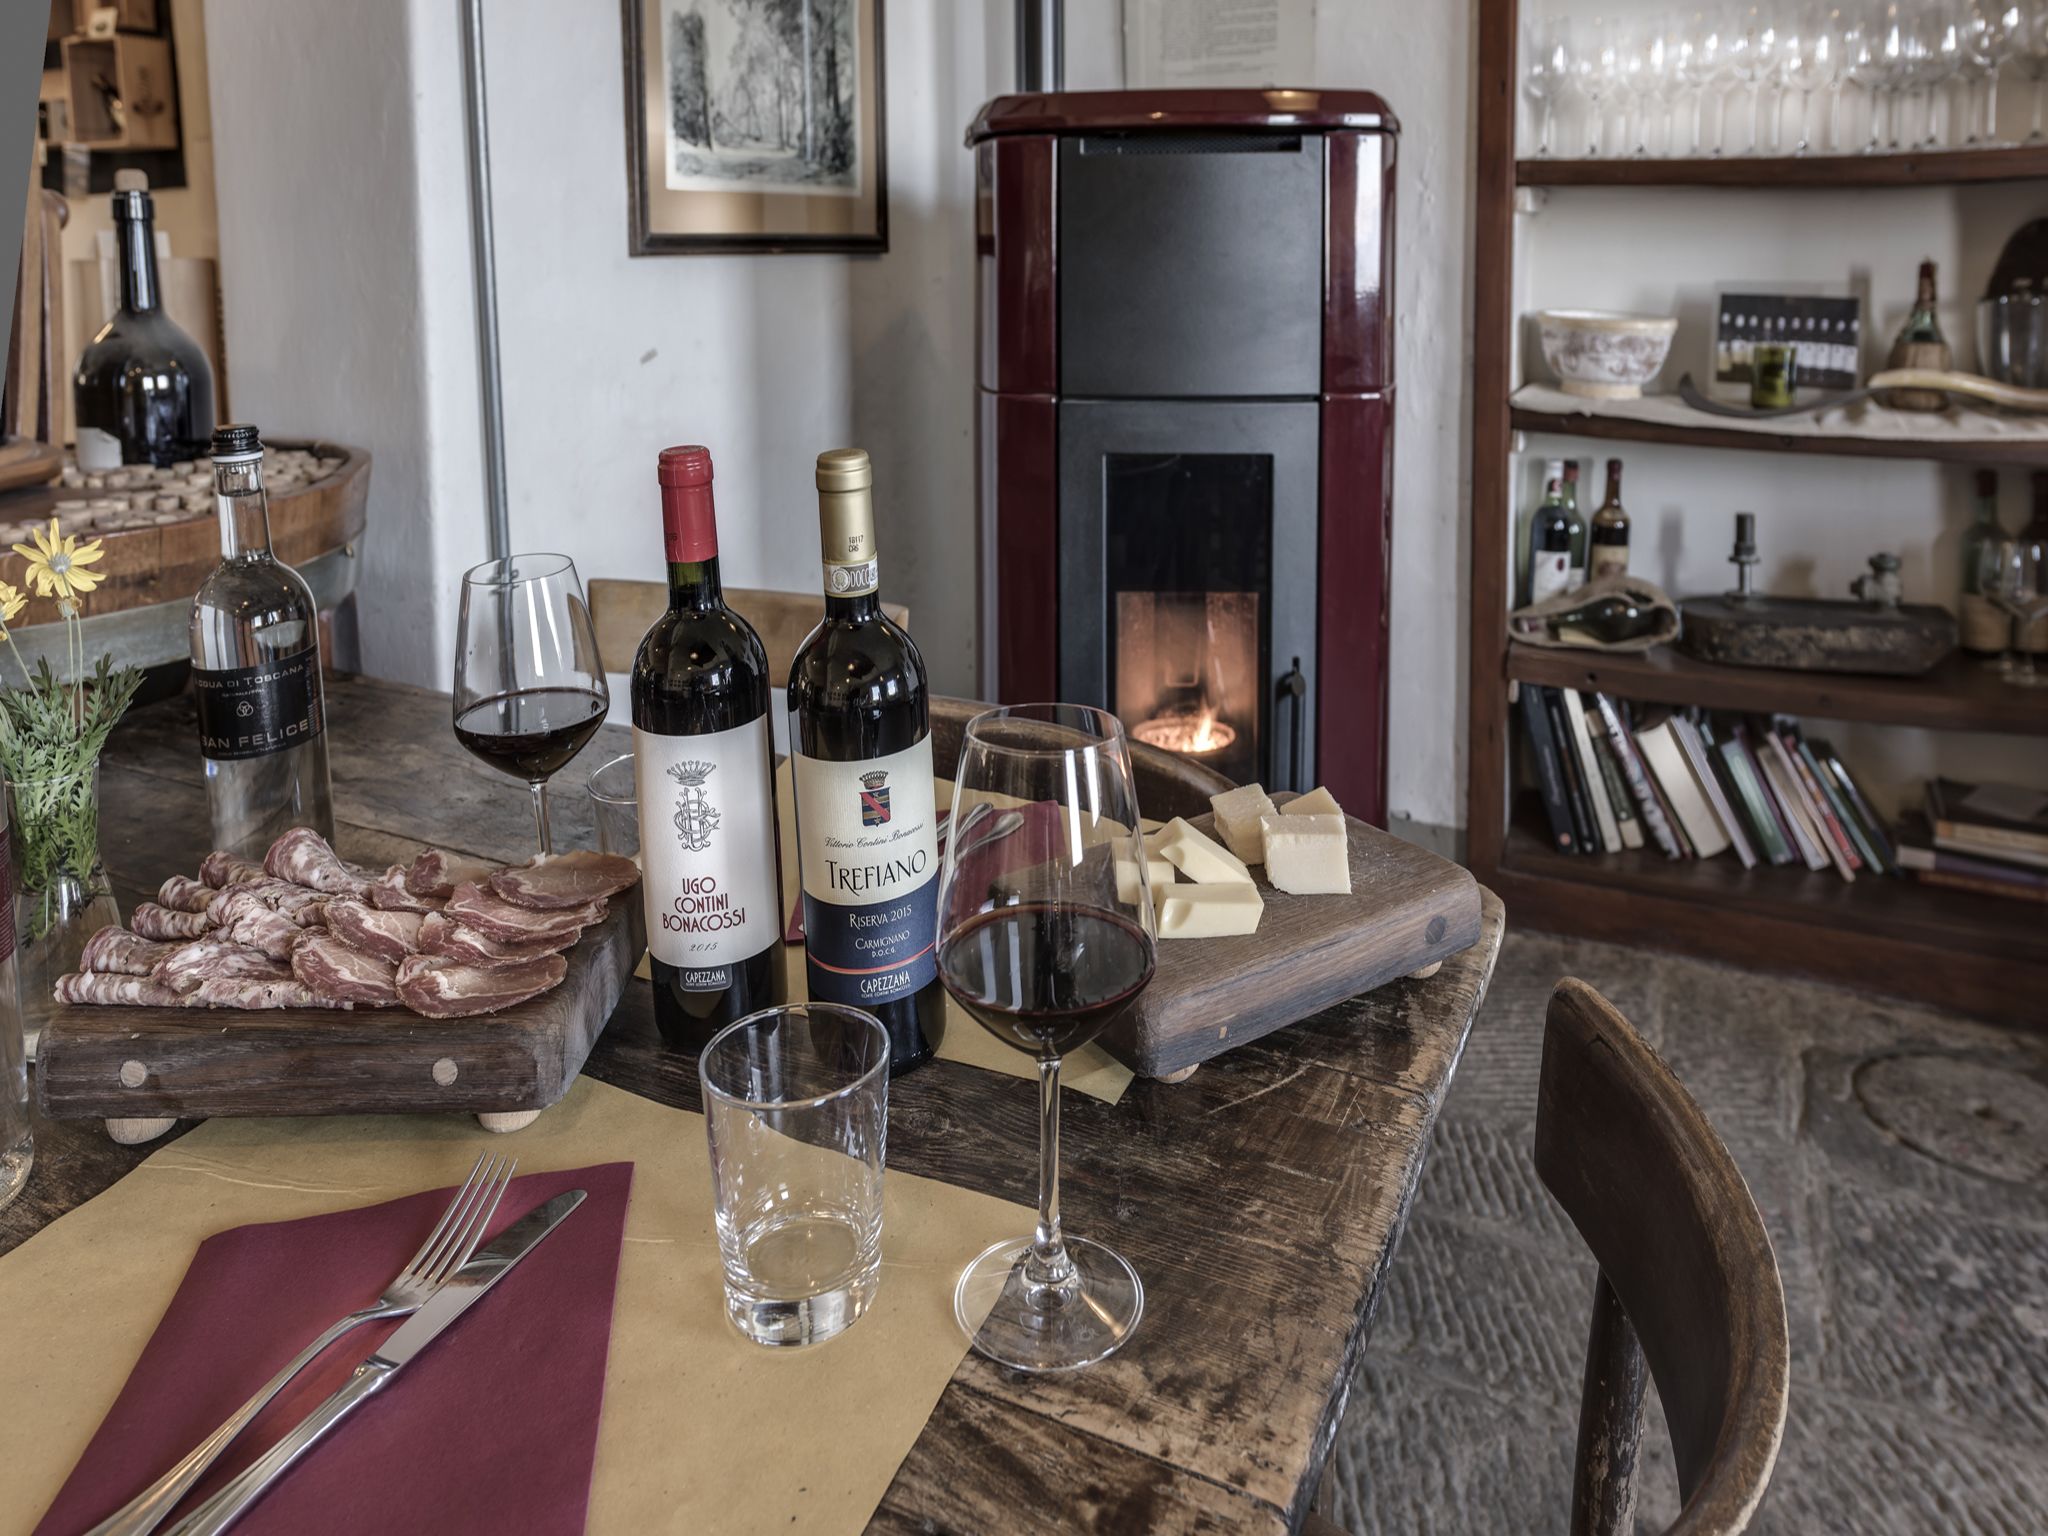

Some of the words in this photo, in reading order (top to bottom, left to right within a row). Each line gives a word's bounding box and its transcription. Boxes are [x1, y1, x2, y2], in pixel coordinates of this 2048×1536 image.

[227, 679, 239, 688] DI
[243, 663, 304, 686] TOSCANA
[238, 718, 309, 746] FELICE
[824, 836, 854, 849] Vittorio
[855, 835, 888, 848] Contini
[825, 849, 927, 896] TREFIANO
[682, 876, 717, 895] UGO
[674, 892, 729, 914] CONTINI
[890, 905, 912, 922] 2015
[662, 907, 746, 933] BONACOSSI
[688, 941, 718, 952] 2015
[855, 929, 910, 951] CARMIGNANO
[685, 969, 726, 983] CAPEZZANA
[860, 970, 911, 993] CAPEZZANA
